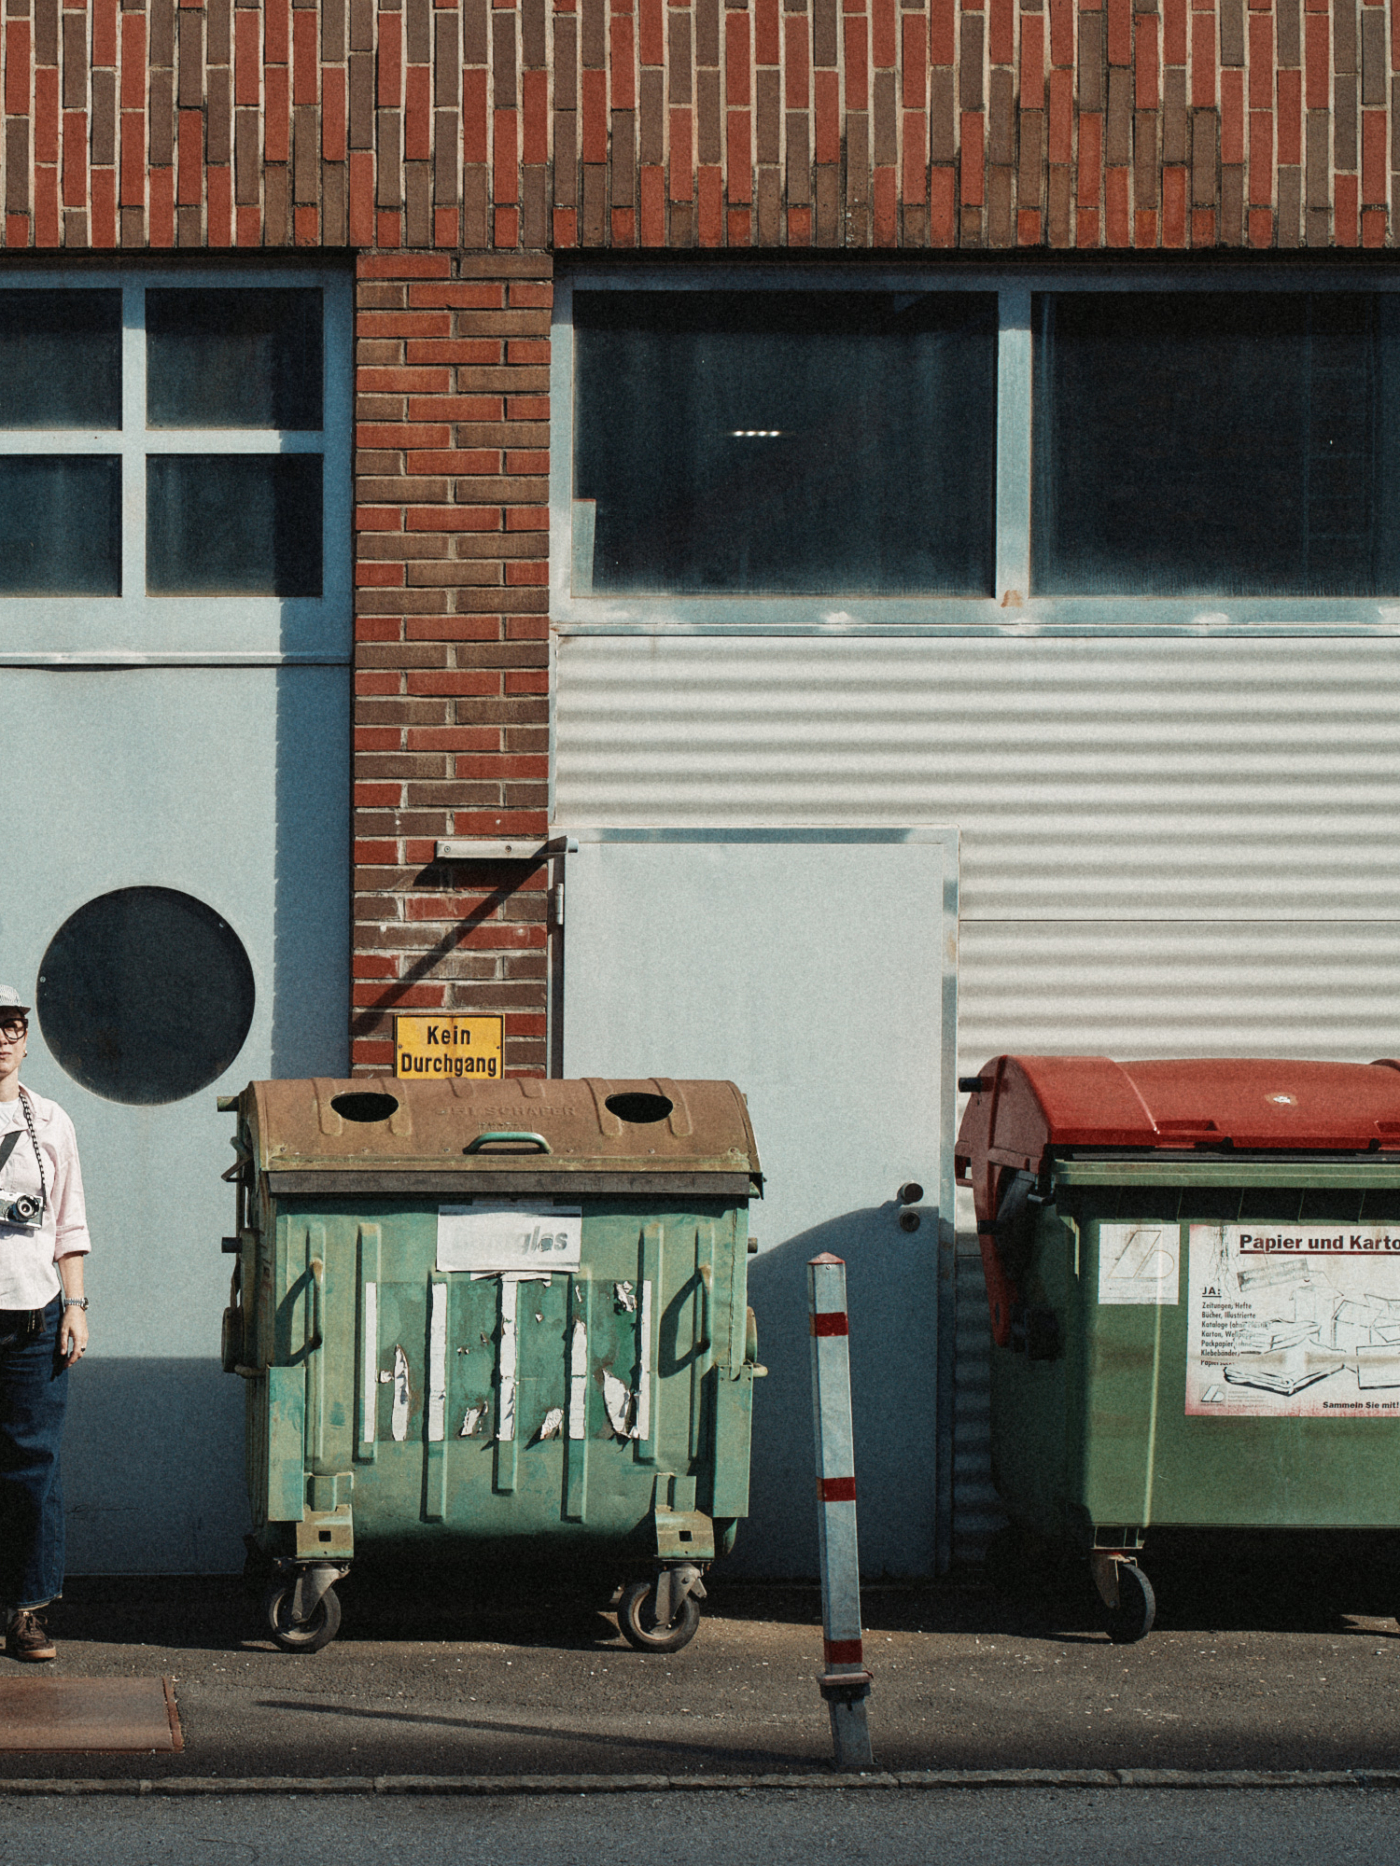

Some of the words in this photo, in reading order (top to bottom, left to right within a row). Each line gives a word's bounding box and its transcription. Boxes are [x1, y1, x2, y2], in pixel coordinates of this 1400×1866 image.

[427, 1025, 471, 1045] Kein
[402, 1053, 497, 1078] Durchgang
[1240, 1234, 1303, 1252] Papier
[1308, 1235, 1344, 1250] und
[1202, 1286, 1222, 1296] JA:
[1235, 1302, 1252, 1310] Hefte
[1202, 1321, 1228, 1330] Kataloge
[1323, 1401, 1364, 1409] Sammeln
[1366, 1401, 1380, 1409] Sie
[1382, 1401, 1400, 1409] mit!
